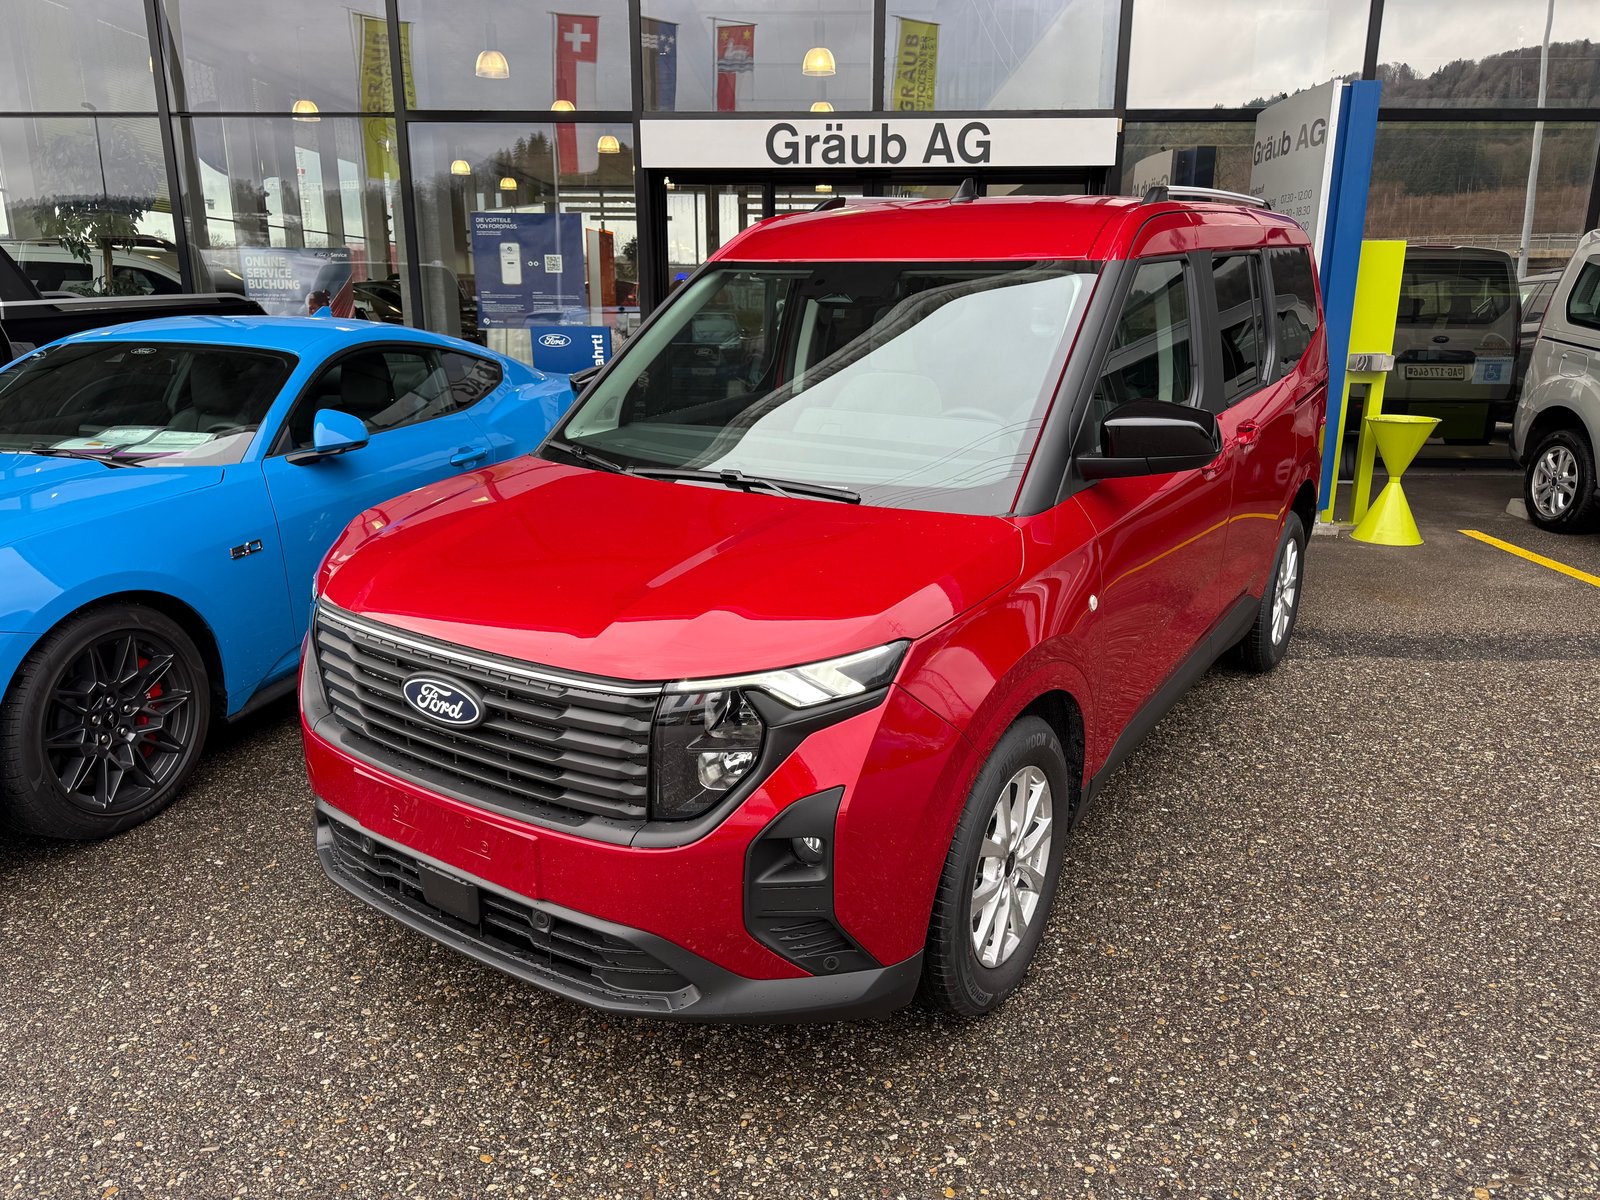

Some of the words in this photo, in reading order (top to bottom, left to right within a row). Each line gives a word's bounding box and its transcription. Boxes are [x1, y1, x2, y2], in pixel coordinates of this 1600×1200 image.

[897, 34, 919, 111] GRÄUB
[916, 35, 929, 110] UTOCENTER
[766, 122, 907, 165] Gräub
[922, 121, 991, 164] AG
[1253, 130, 1291, 166] Gräub
[1295, 118, 1326, 151] AG
[1298, 189, 1312, 201] 12.00
[1296, 205, 1311, 216] 18.30
[245, 256, 286, 267] ONLINE
[247, 268, 292, 278] SERVICE
[248, 279, 300, 290] BUCHUNG
[544, 335, 566, 345] Ford
[591, 334, 605, 366] ahrt!
[230, 539, 263, 560] 5.0
[417, 683, 464, 719] Ford
